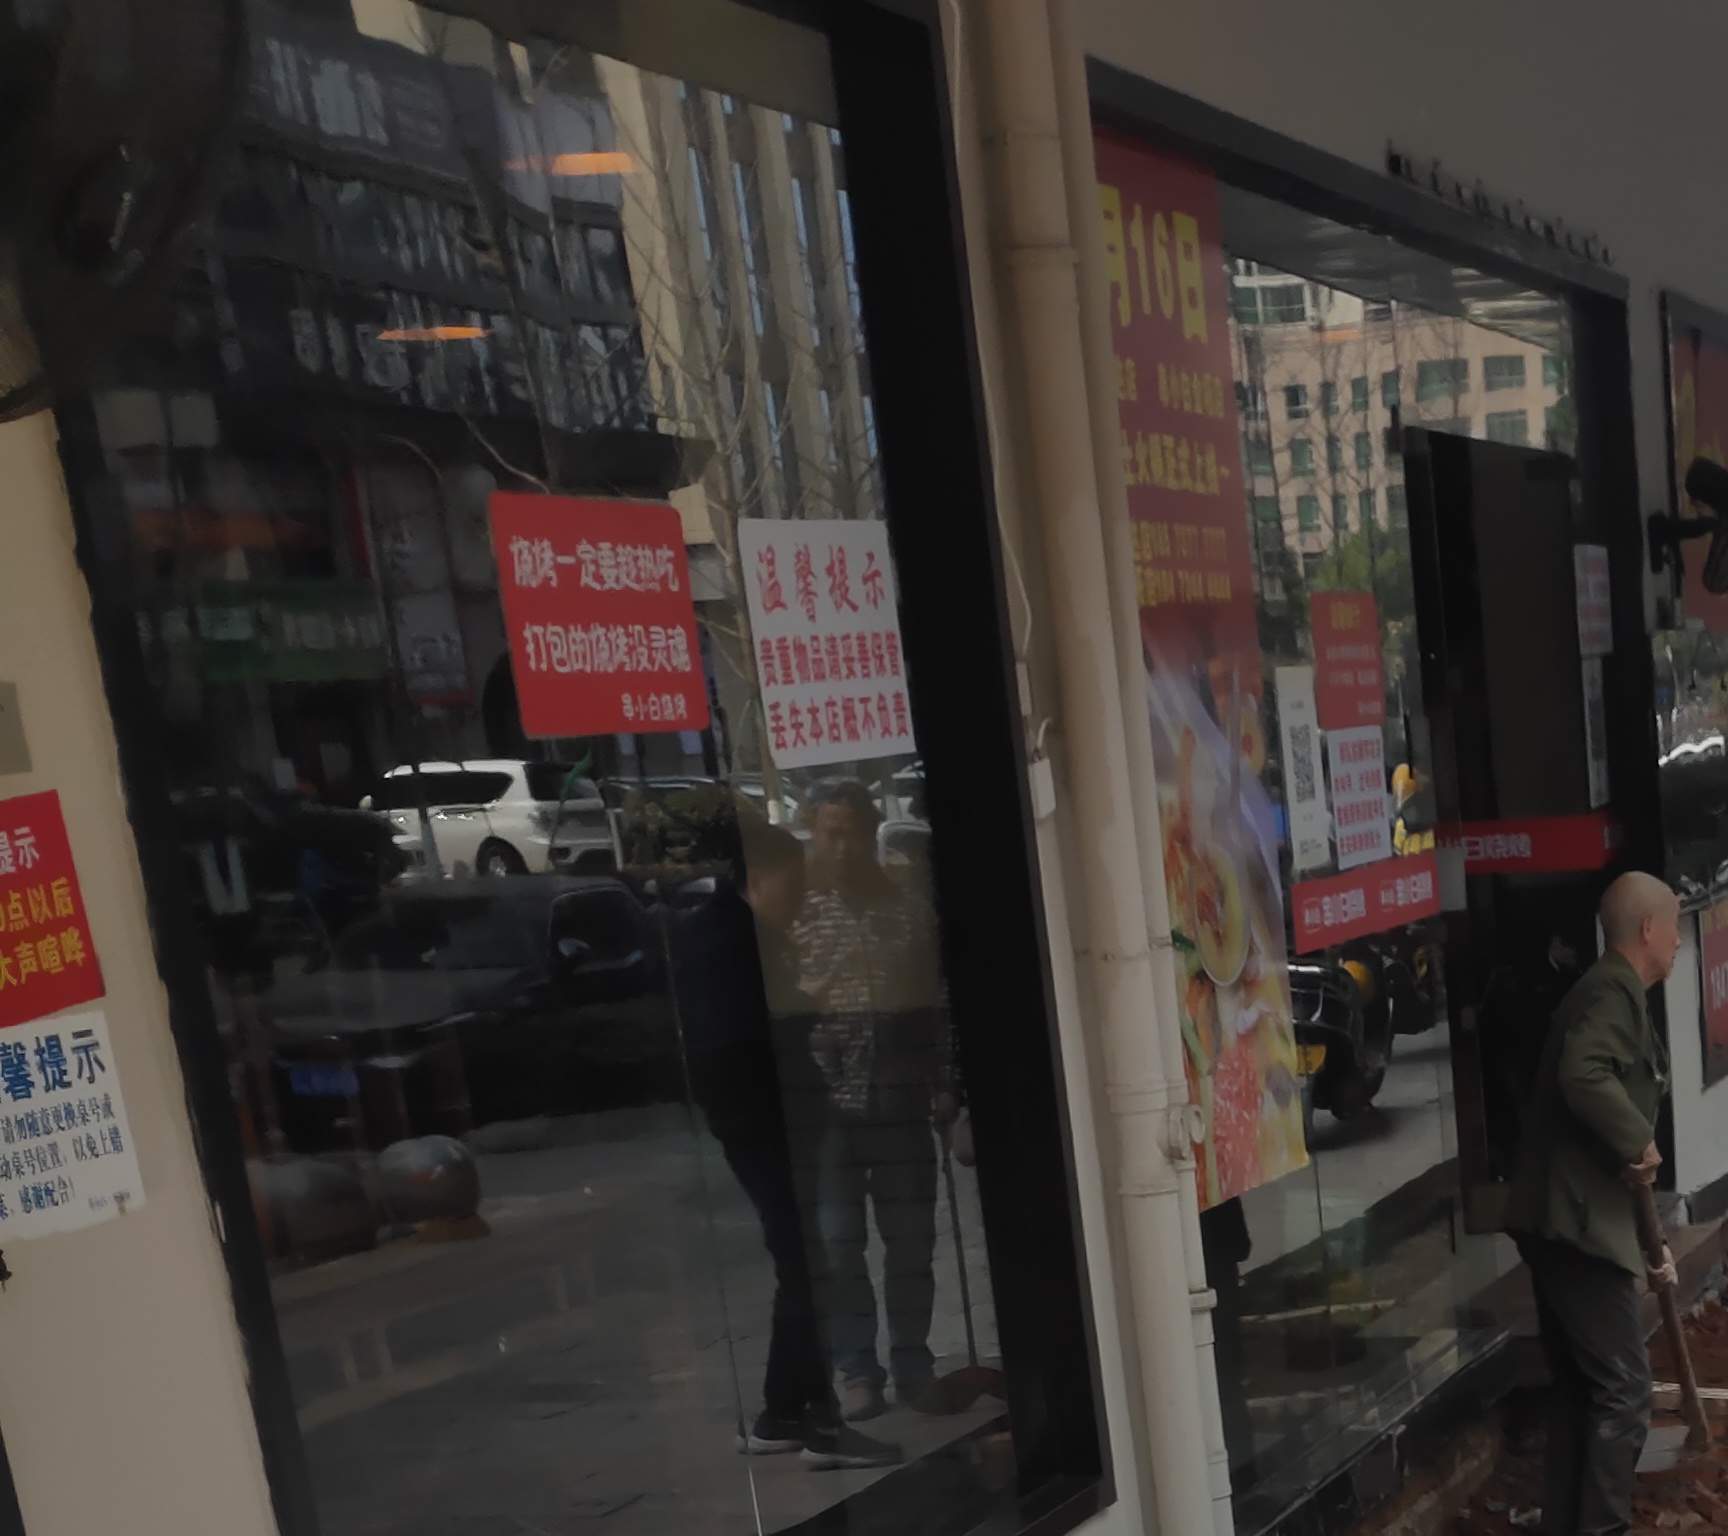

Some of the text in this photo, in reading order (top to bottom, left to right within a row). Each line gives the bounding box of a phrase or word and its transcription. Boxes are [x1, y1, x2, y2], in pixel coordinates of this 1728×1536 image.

[508, 534, 680, 592] 烧烤一定要趁热吃
[757, 543, 886, 623] 温馨提示
[522, 621, 692, 674] 打包的烧烤没灵魂
[760, 630, 901, 687] 贵重物品请妥善保管
[769, 692, 908, 750] 丢失本店概不负责
